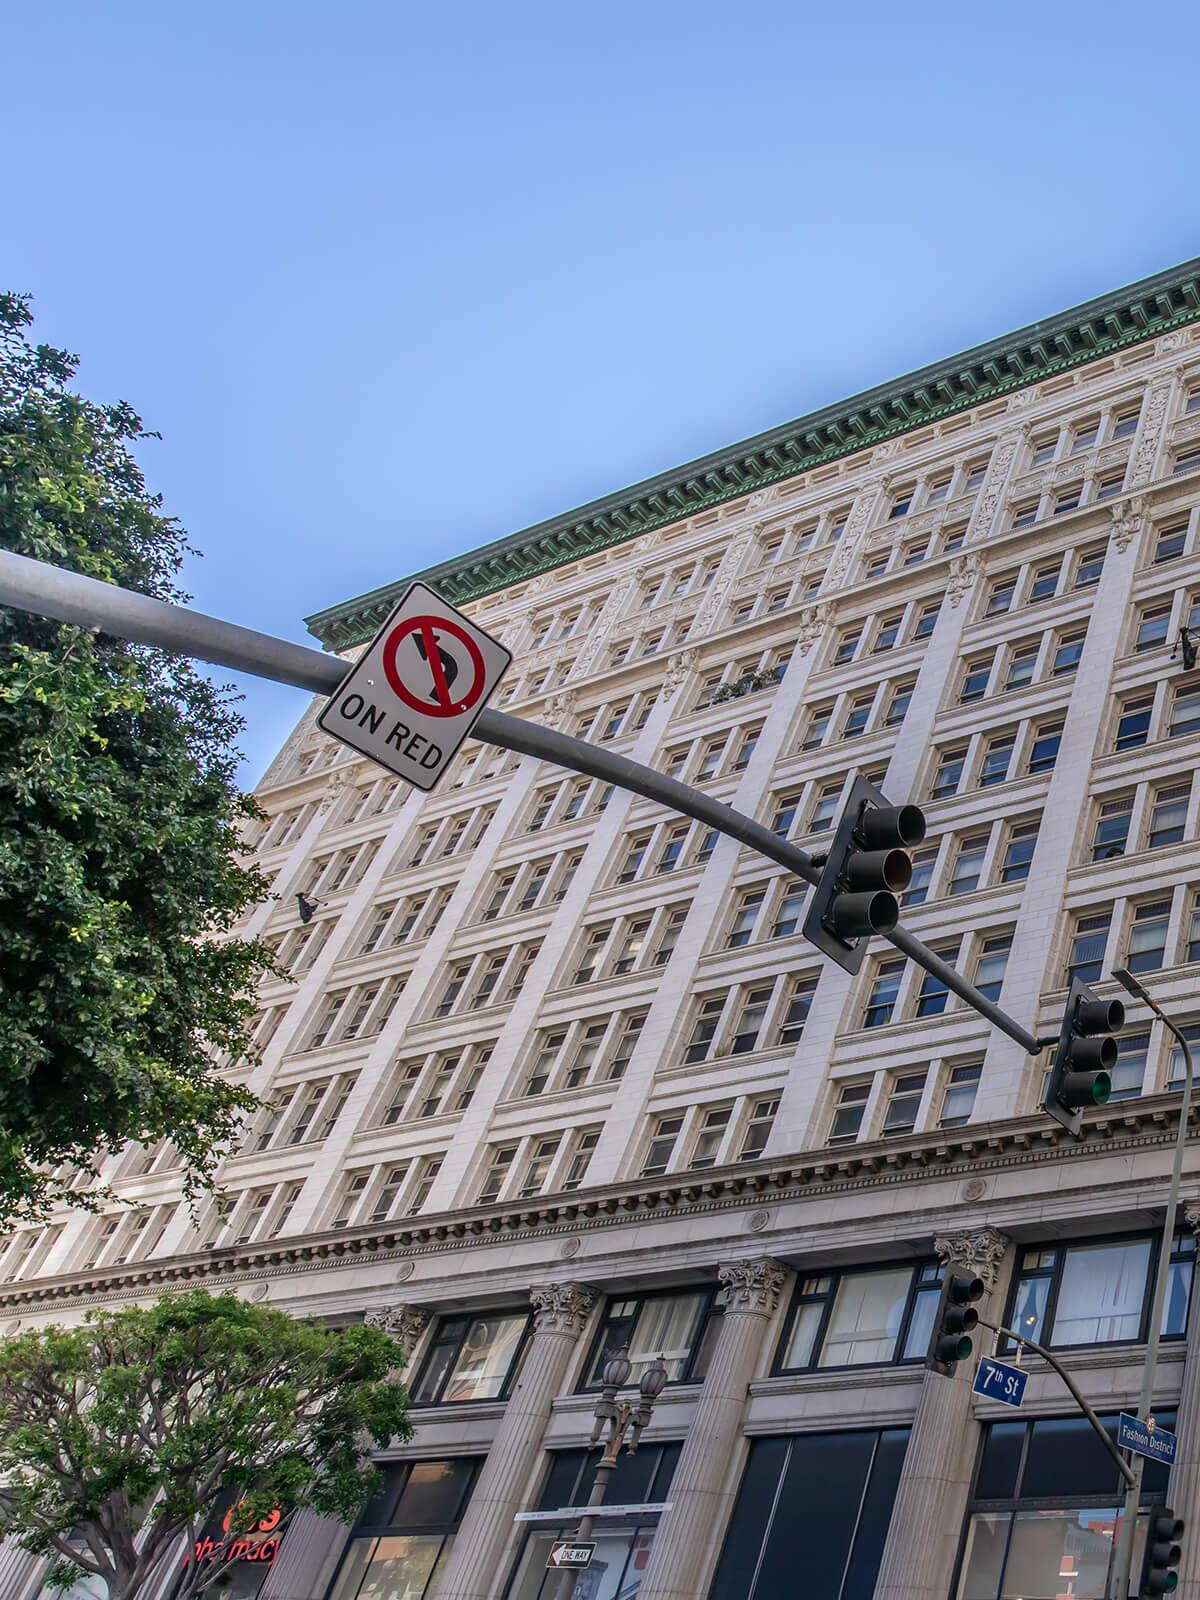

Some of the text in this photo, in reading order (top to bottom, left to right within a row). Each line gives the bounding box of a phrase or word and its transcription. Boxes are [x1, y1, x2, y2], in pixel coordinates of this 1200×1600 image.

[340, 693, 443, 770] ON RED
[983, 1366, 1019, 1397] 7th St
[1122, 1424, 1148, 1446] Fashion
[1149, 1436, 1174, 1456] District
[561, 1550, 589, 1560] ONE WAY
